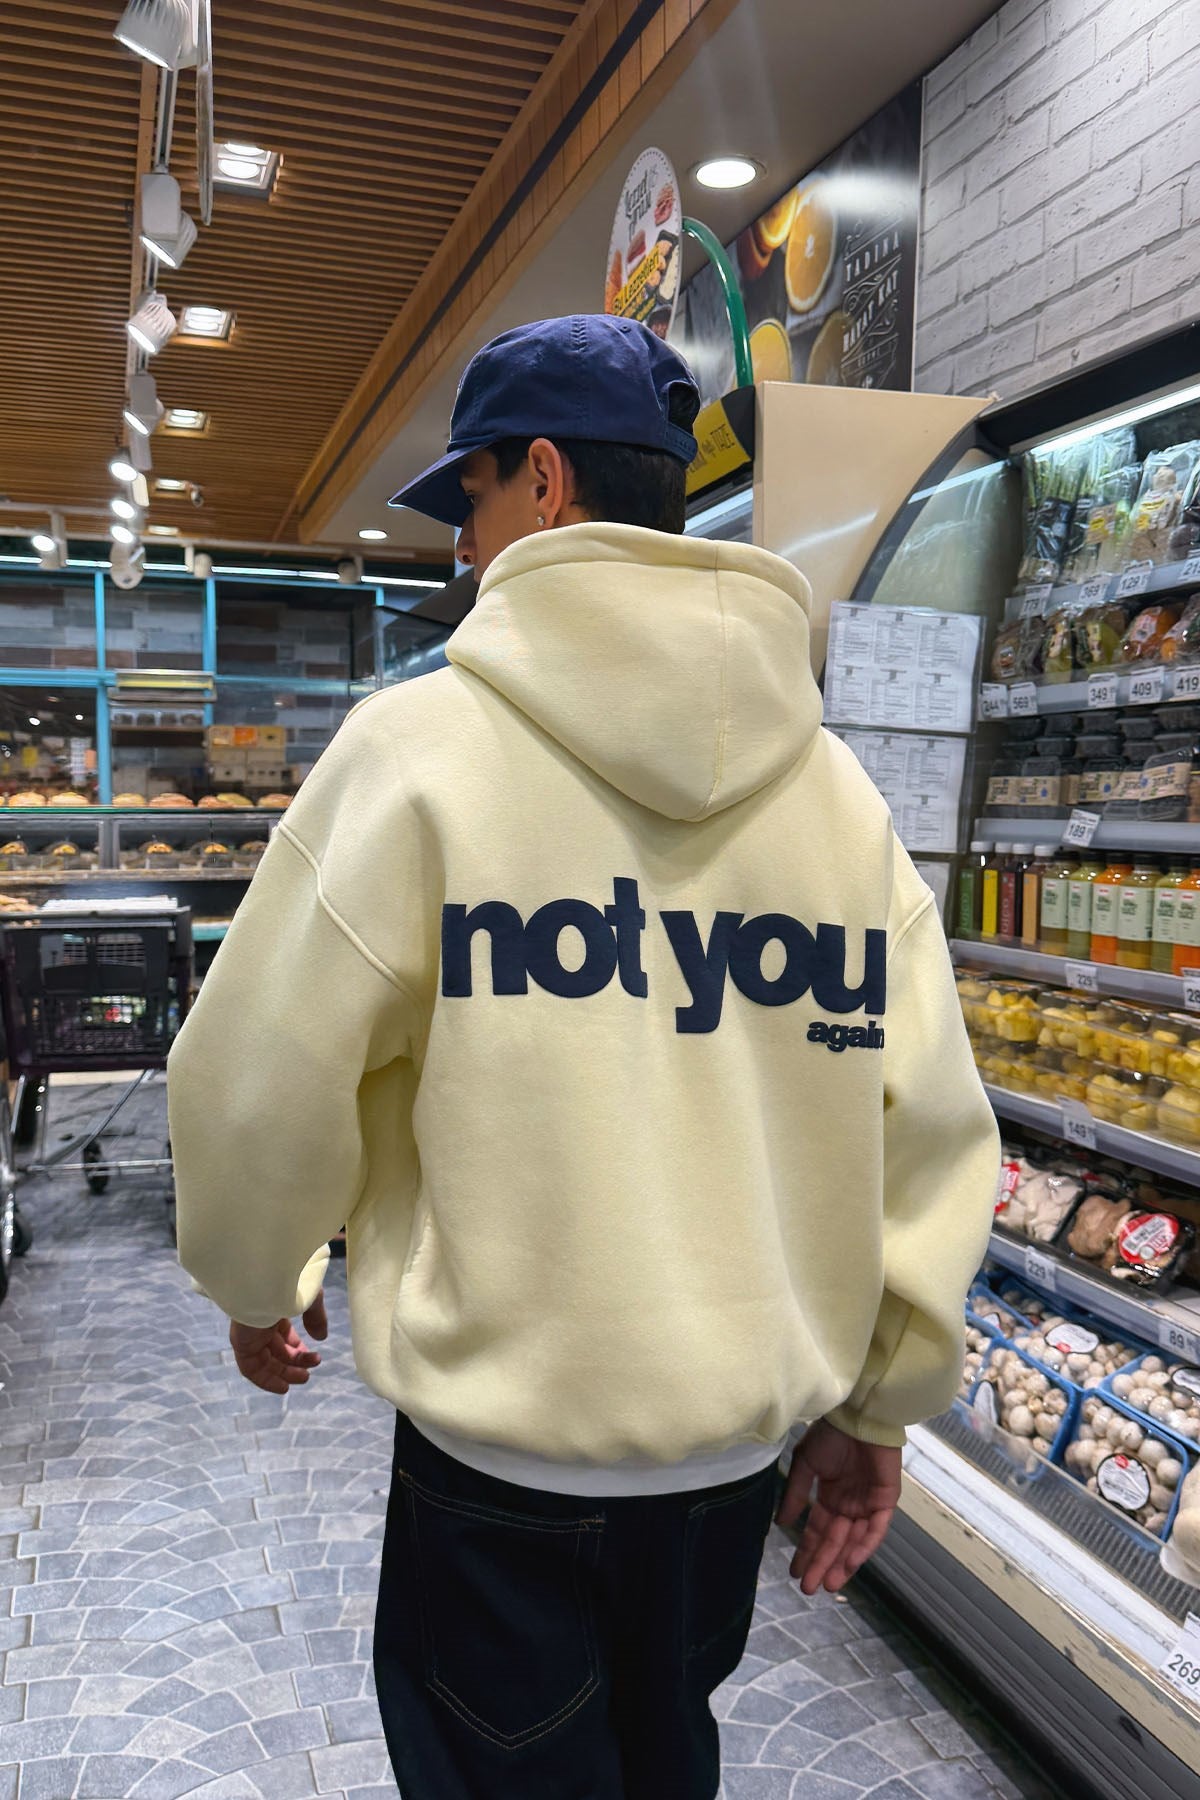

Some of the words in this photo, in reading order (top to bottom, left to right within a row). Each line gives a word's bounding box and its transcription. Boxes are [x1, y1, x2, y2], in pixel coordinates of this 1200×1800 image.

[1131, 682, 1152, 697] 409
[1176, 676, 1199, 692] 419
[441, 877, 648, 999] not
[659, 910, 887, 1034] you
[1168, 1653, 1200, 1685] 269
